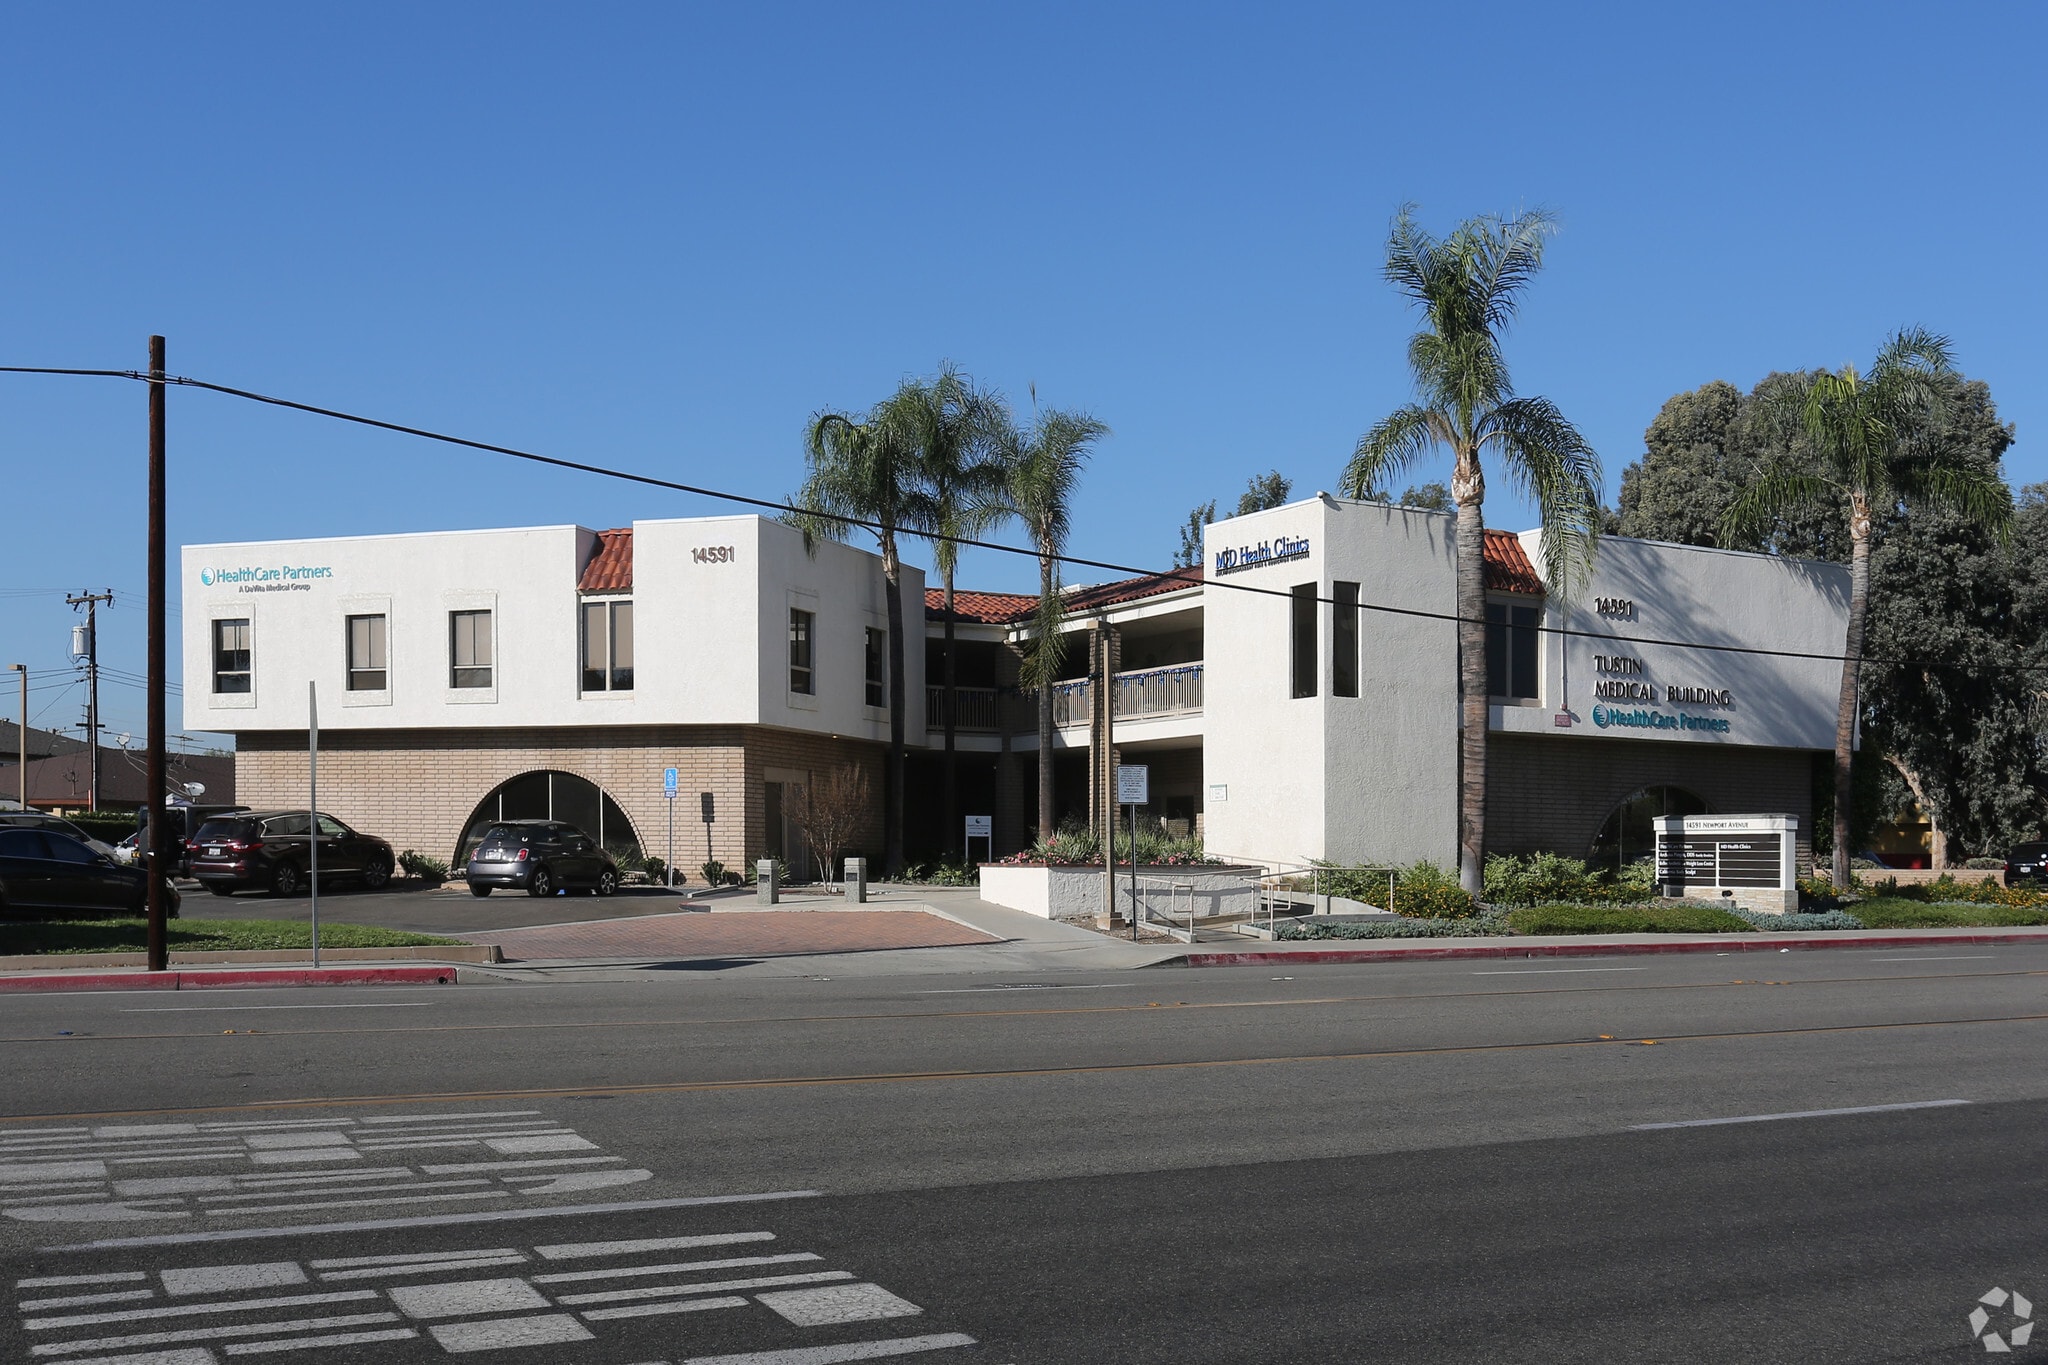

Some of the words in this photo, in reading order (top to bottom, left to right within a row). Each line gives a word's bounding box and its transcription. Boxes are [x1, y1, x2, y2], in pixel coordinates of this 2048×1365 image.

[691, 545, 735, 564] 14591
[1239, 541, 1271, 564] Health
[1274, 535, 1310, 556] Clinics
[217, 567, 280, 583] HealthCare
[266, 583, 290, 592] Medical
[291, 583, 311, 592] Group
[1593, 597, 1633, 616] 14591
[1593, 655, 1643, 675] TUSTIN
[1593, 680, 1655, 700] MEDICAL
[1666, 685, 1730, 706] BUILDING
[1609, 708, 1678, 729] HealthCare
[1680, 712, 1731, 732] Partners
